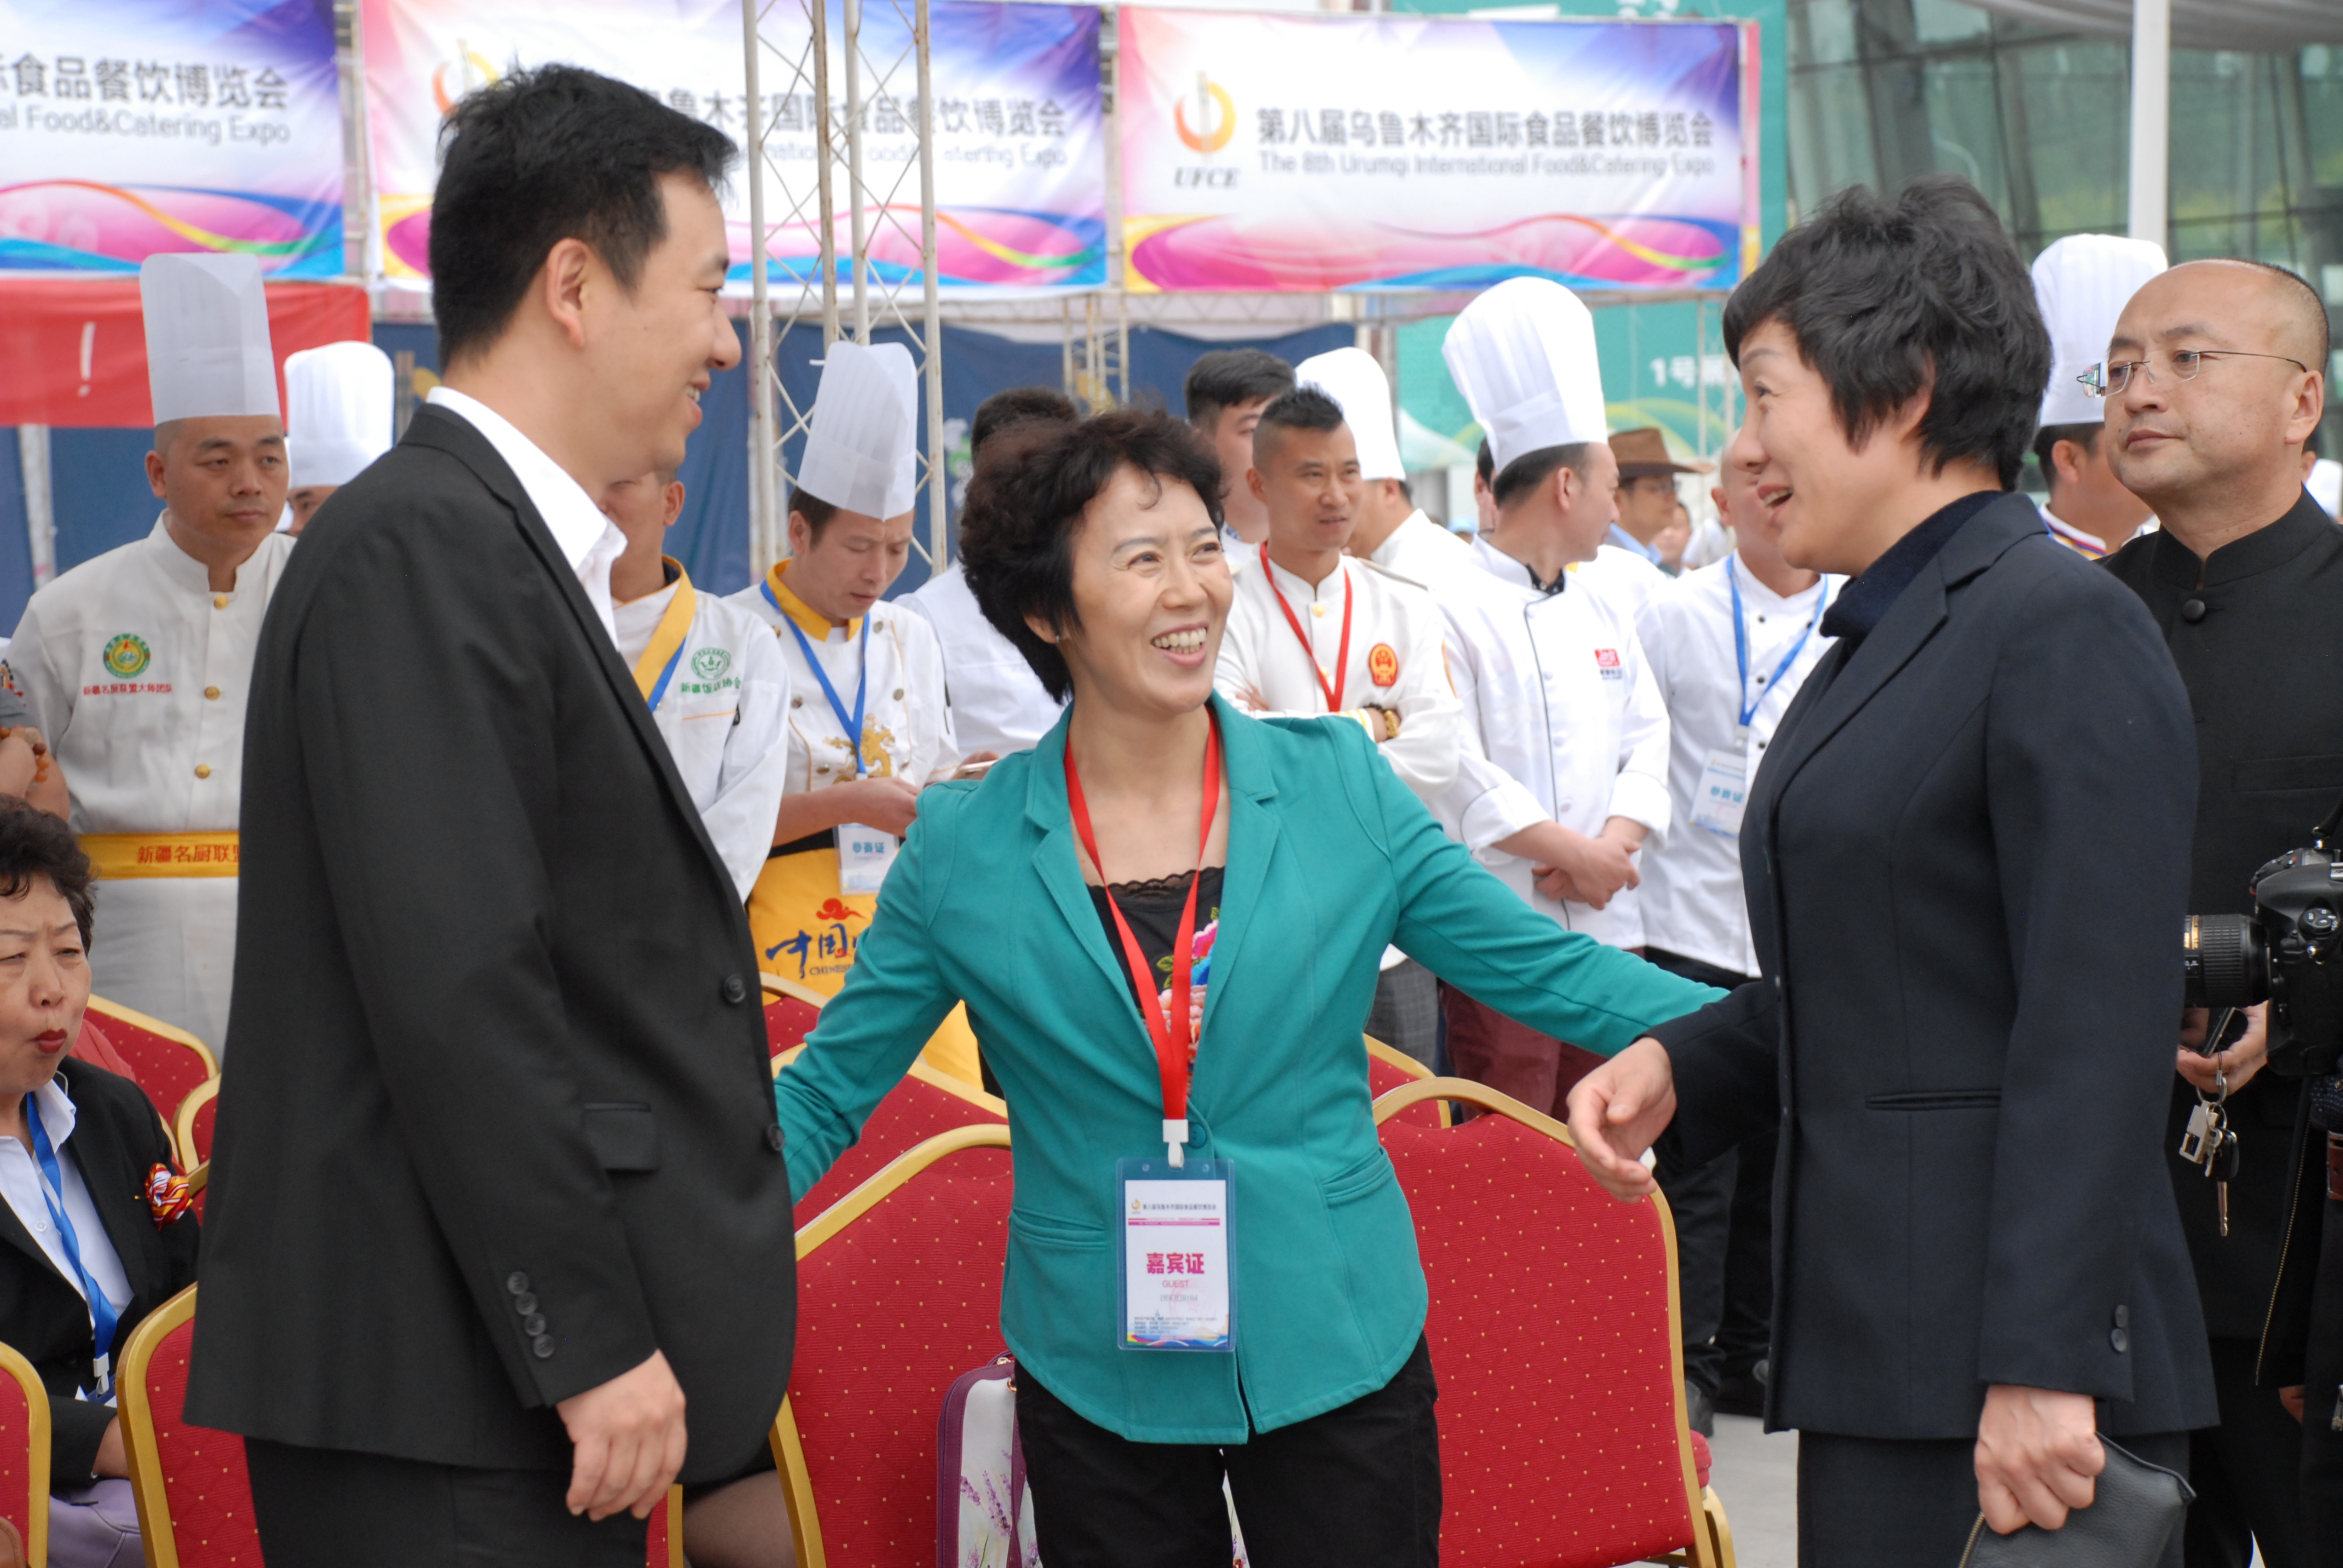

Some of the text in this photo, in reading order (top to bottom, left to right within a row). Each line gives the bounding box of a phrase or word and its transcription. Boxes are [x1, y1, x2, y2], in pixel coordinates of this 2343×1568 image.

[229, 115, 292, 147] Expo
[1256, 107, 1712, 147] 第八届乌鲁木齐国际食品餐饮博览会
[1175, 167, 1240, 188] UFCE
[1259, 150, 1297, 173] The
[1302, 151, 1335, 174] 8th
[1340, 152, 1411, 179] Urumqi
[1414, 152, 1528, 176] International
[1671, 151, 1715, 179] Expo
[765, 923, 858, 979] 中国
[1147, 1252, 1205, 1274] 嘉宾证
